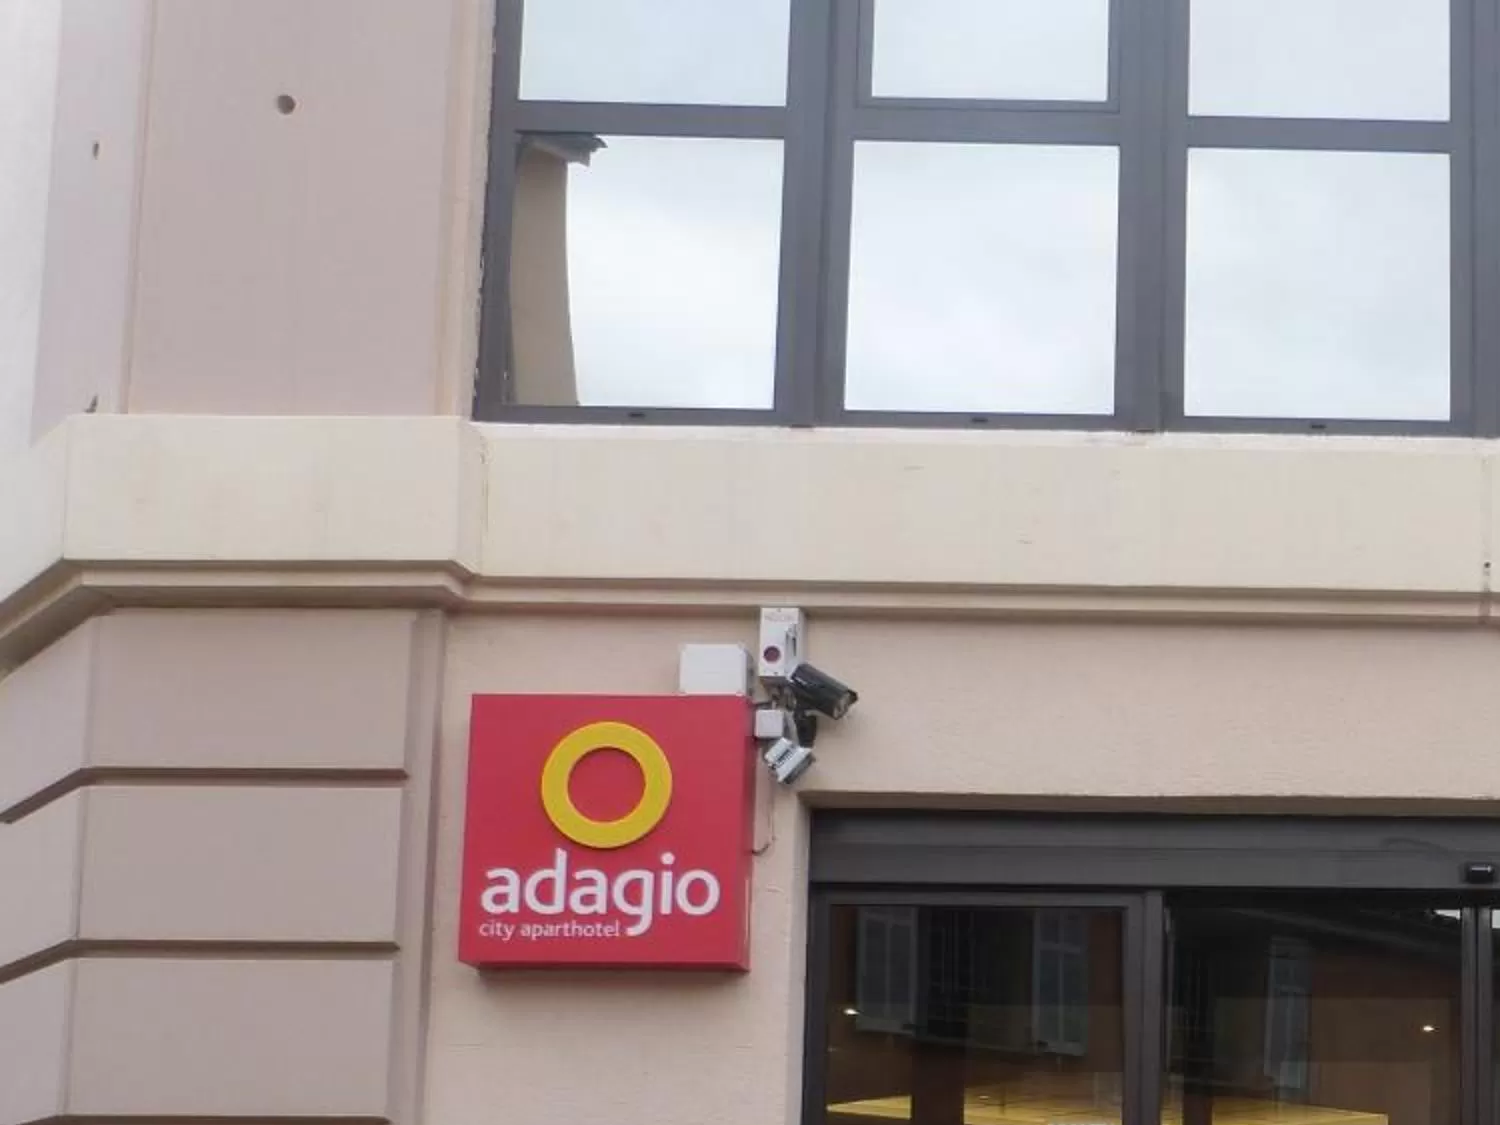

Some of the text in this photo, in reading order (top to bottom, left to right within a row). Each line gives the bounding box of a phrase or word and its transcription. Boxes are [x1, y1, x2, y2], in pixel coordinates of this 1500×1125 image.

[480, 848, 720, 937] adagio
[479, 920, 620, 941] city aparthotel
